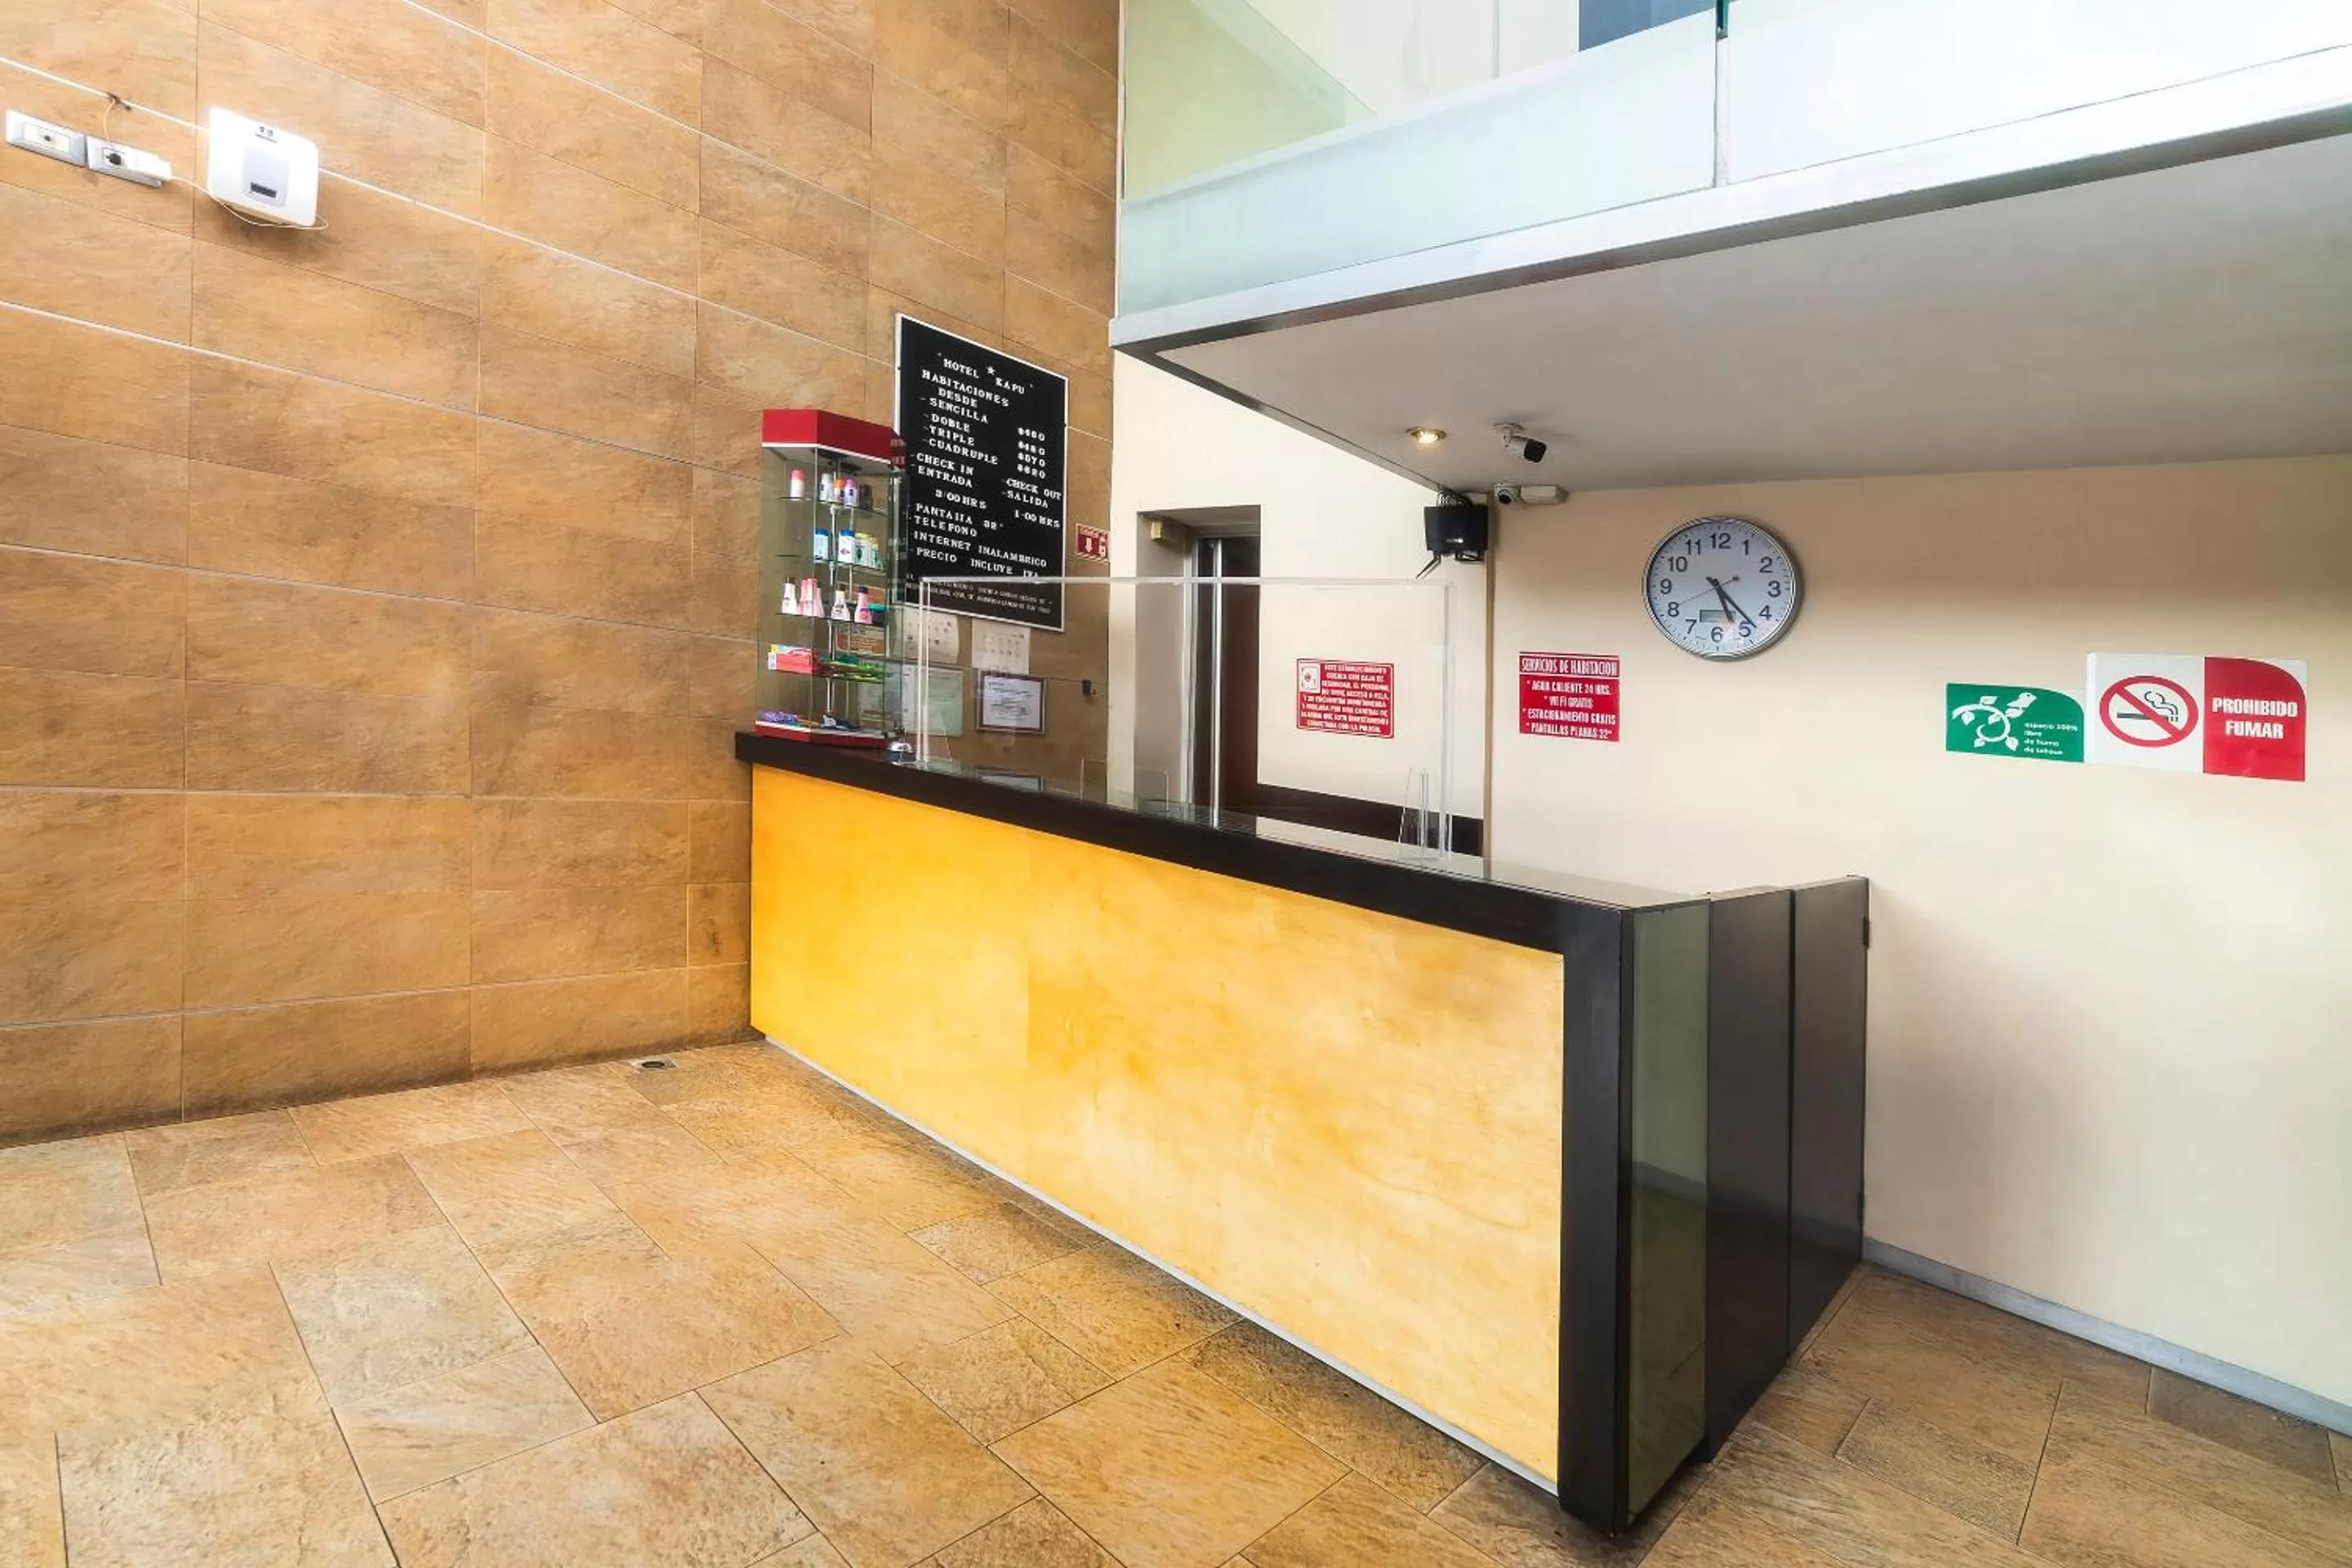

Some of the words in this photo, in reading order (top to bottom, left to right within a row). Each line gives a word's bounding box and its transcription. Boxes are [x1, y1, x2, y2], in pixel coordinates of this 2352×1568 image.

[943, 359, 979, 378] HOTEL
[996, 376, 1025, 394] KAPU
[922, 369, 1009, 407] HABITACIONES
[938, 387, 978, 408] DESDE
[929, 398, 988, 424] SENCILLA
[931, 413, 970, 433] DOBLE
[929, 424, 974, 446] TRIPLE
[929, 438, 998, 464] CUADRUPLE
[916, 452, 956, 471] CHECK
[960, 463, 973, 476] IN
[918, 465, 973, 488] ENTRADA
[1005, 478, 1039, 495] CHECK
[1044, 488, 1062, 501] OUT
[1007, 490, 1048, 509] SALIDA
[914, 515, 978, 537] TELEFONO
[914, 530, 971, 551] INTERNET
[978, 545, 1047, 568] INALAMBRICO
[1686, 539, 1701, 556] 11
[1709, 532, 1731, 550] 12
[1743, 539, 1749, 556] 1
[916, 546, 958, 563] PRECIO
[970, 558, 1013, 575] INCLUYE
[1668, 556, 1688, 572] 10
[1759, 556, 1773, 573] 2
[1659, 578, 1672, 595] 9
[1767, 581, 1781, 598] 3
[1668, 602, 1679, 617] 8
[1758, 605, 1772, 621] 4
[1686, 619, 1697, 635] 7
[1711, 626, 1723, 643] 6
[1738, 621, 1751, 637] 5
[1522, 657, 1557, 674] SERVICIOS
[1559, 659, 1569, 674] DE
[1552, 682, 1583, 693] CALIENTE
[2212, 697, 2298, 718] PROHIBIDO
[2225, 719, 2283, 739] FUMAR
